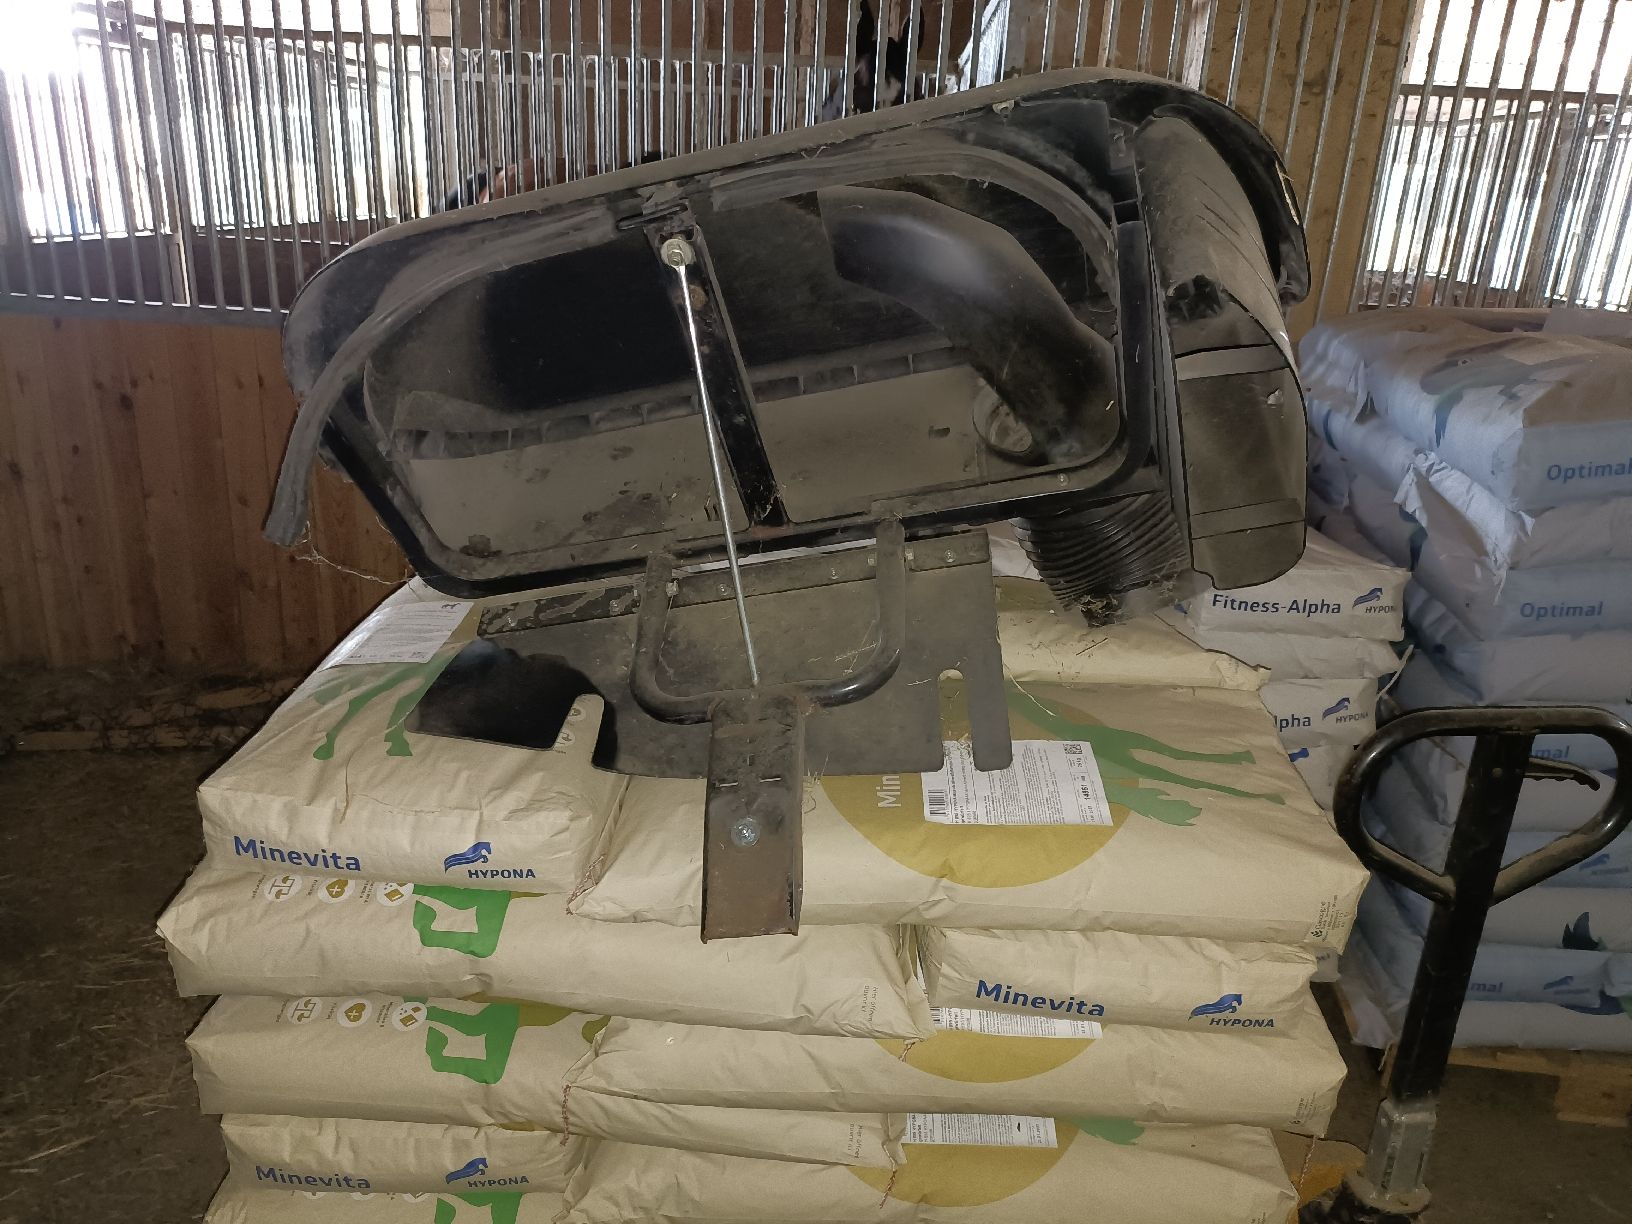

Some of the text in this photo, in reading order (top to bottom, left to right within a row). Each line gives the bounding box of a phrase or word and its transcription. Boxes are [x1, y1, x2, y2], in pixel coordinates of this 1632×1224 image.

[1546, 457, 1632, 484] Optimal
[1212, 593, 1341, 617] Fitness-Alpha
[1520, 602, 1603, 621] Optimal
[876, 775, 902, 808] Min
[233, 835, 361, 872] Minevita
[467, 868, 536, 879] HYPONA
[975, 979, 1105, 1017] Minevita
[1208, 1017, 1275, 1029] HYPONA
[255, 1165, 371, 1189] Minevita
[467, 1175, 530, 1188] HYPONA
